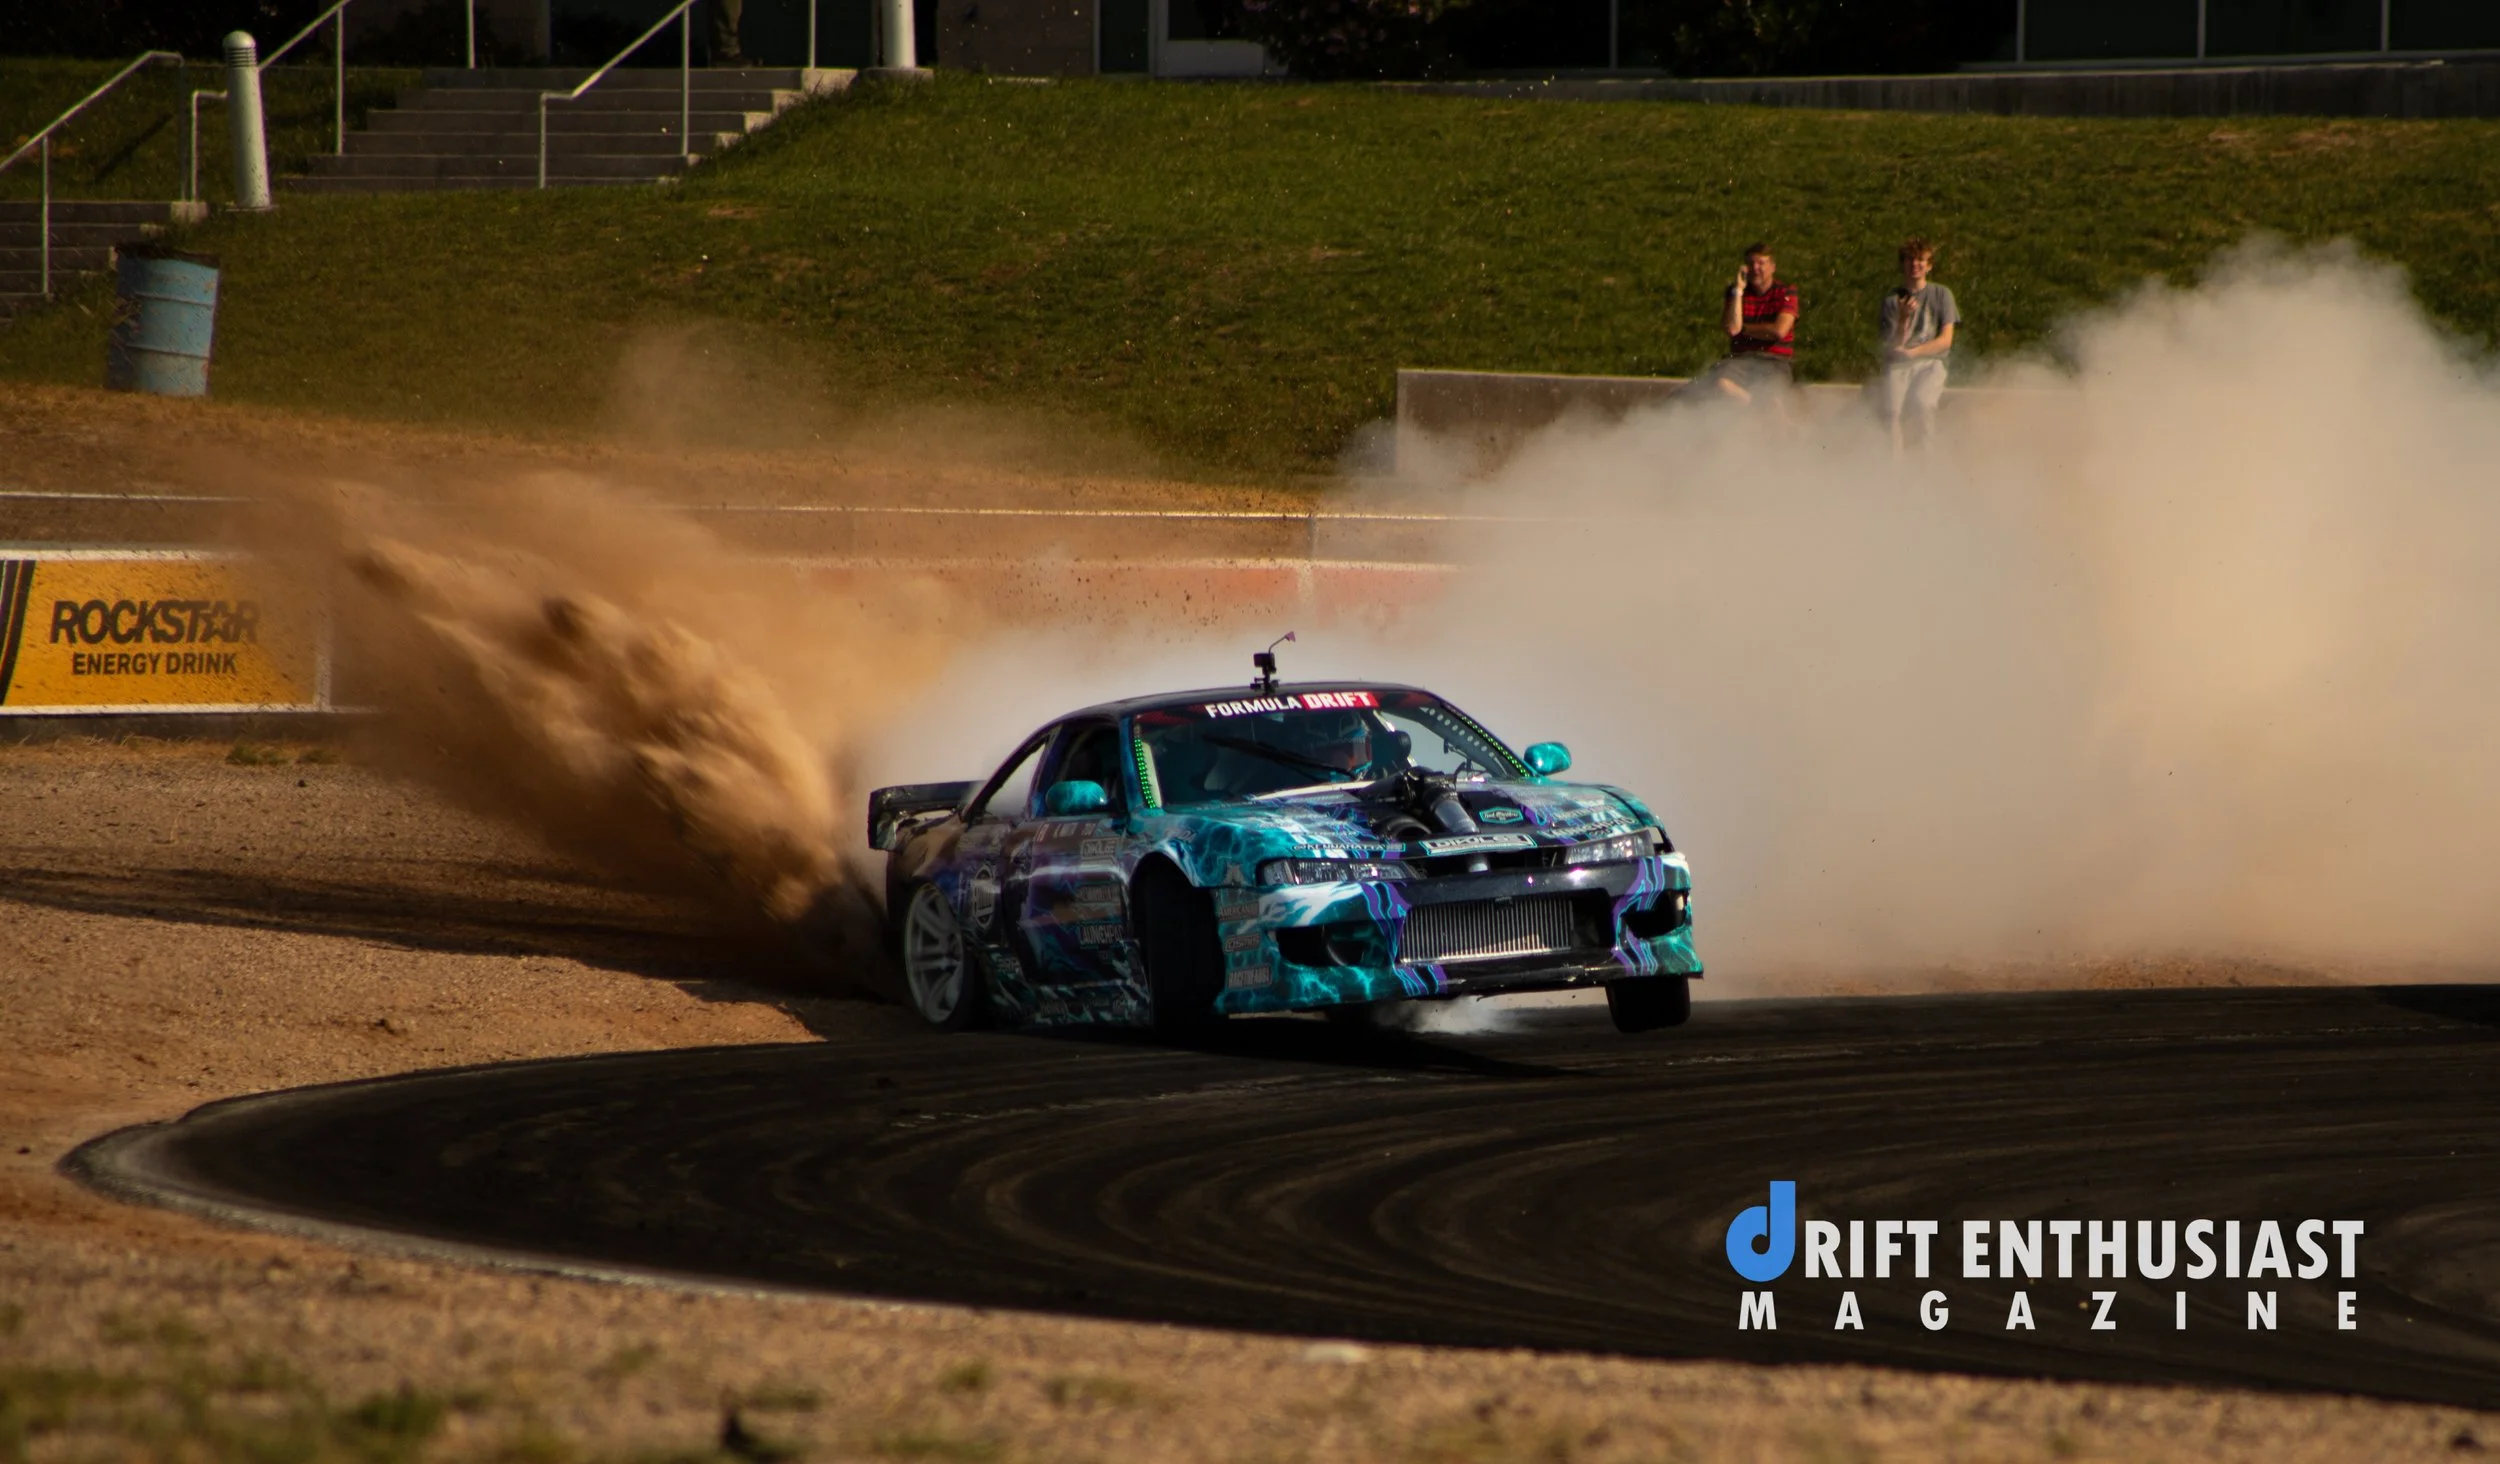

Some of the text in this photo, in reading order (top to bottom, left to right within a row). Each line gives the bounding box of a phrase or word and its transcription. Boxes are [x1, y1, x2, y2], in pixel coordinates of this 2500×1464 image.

[49, 599, 261, 645] ROCKSTAR
[72, 652, 238, 675] ENERGY DRINK
[1203, 691, 1373, 719] FORMULA DRIFT
